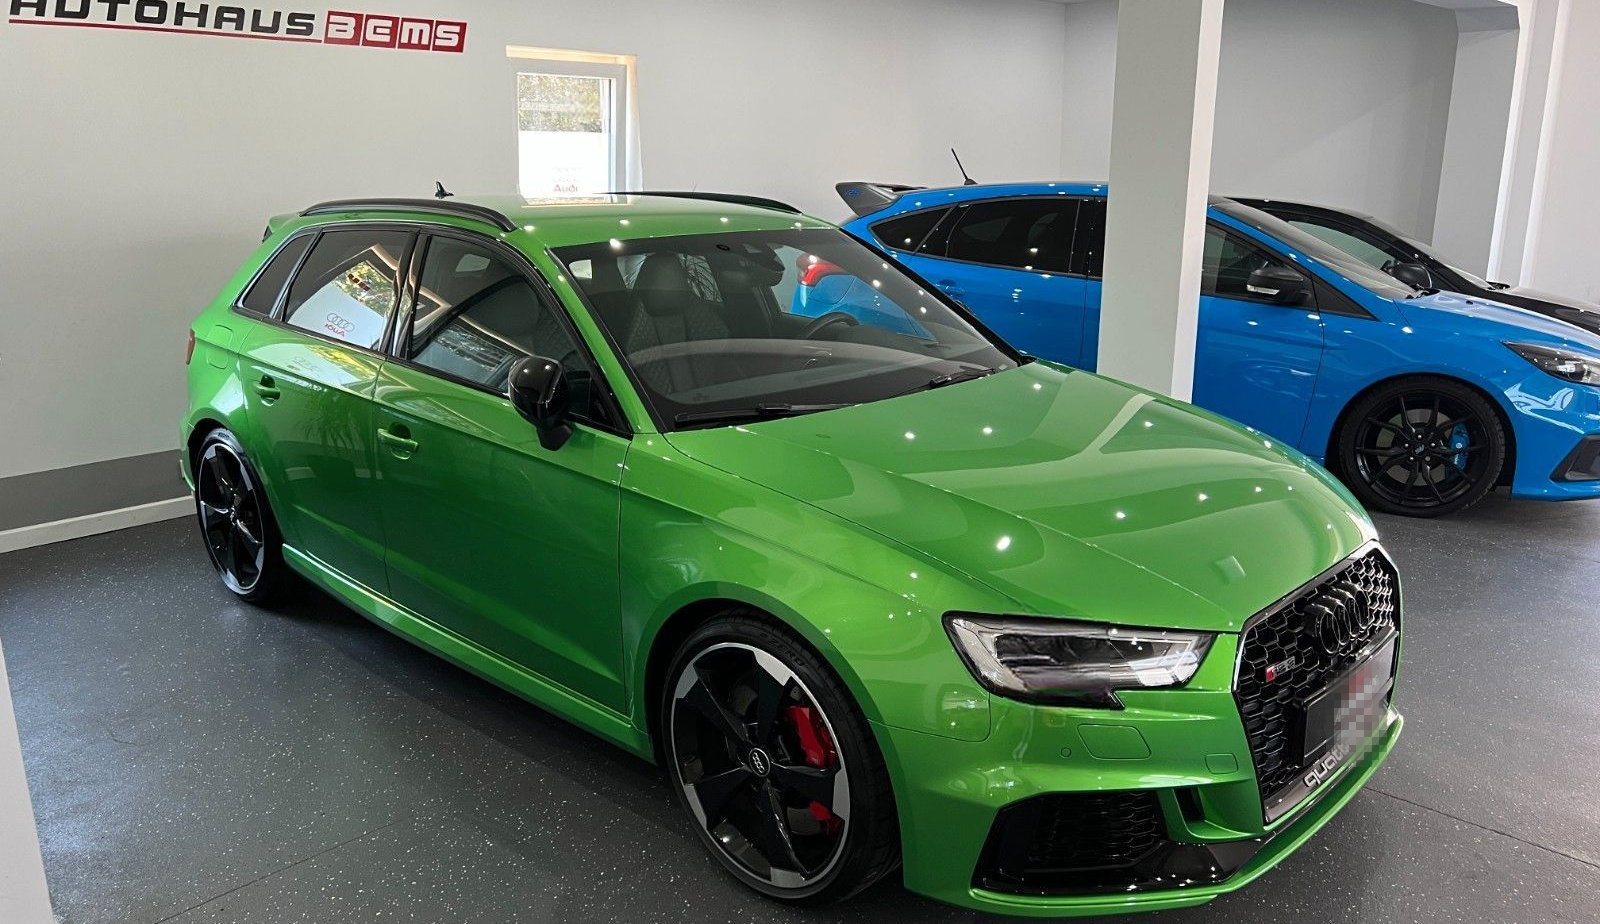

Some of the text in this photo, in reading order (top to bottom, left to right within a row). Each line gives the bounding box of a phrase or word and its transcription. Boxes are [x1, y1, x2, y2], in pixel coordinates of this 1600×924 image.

[8, 0, 465, 51] AUTOHAUS BEMS
[553, 183, 579, 193] Audi
